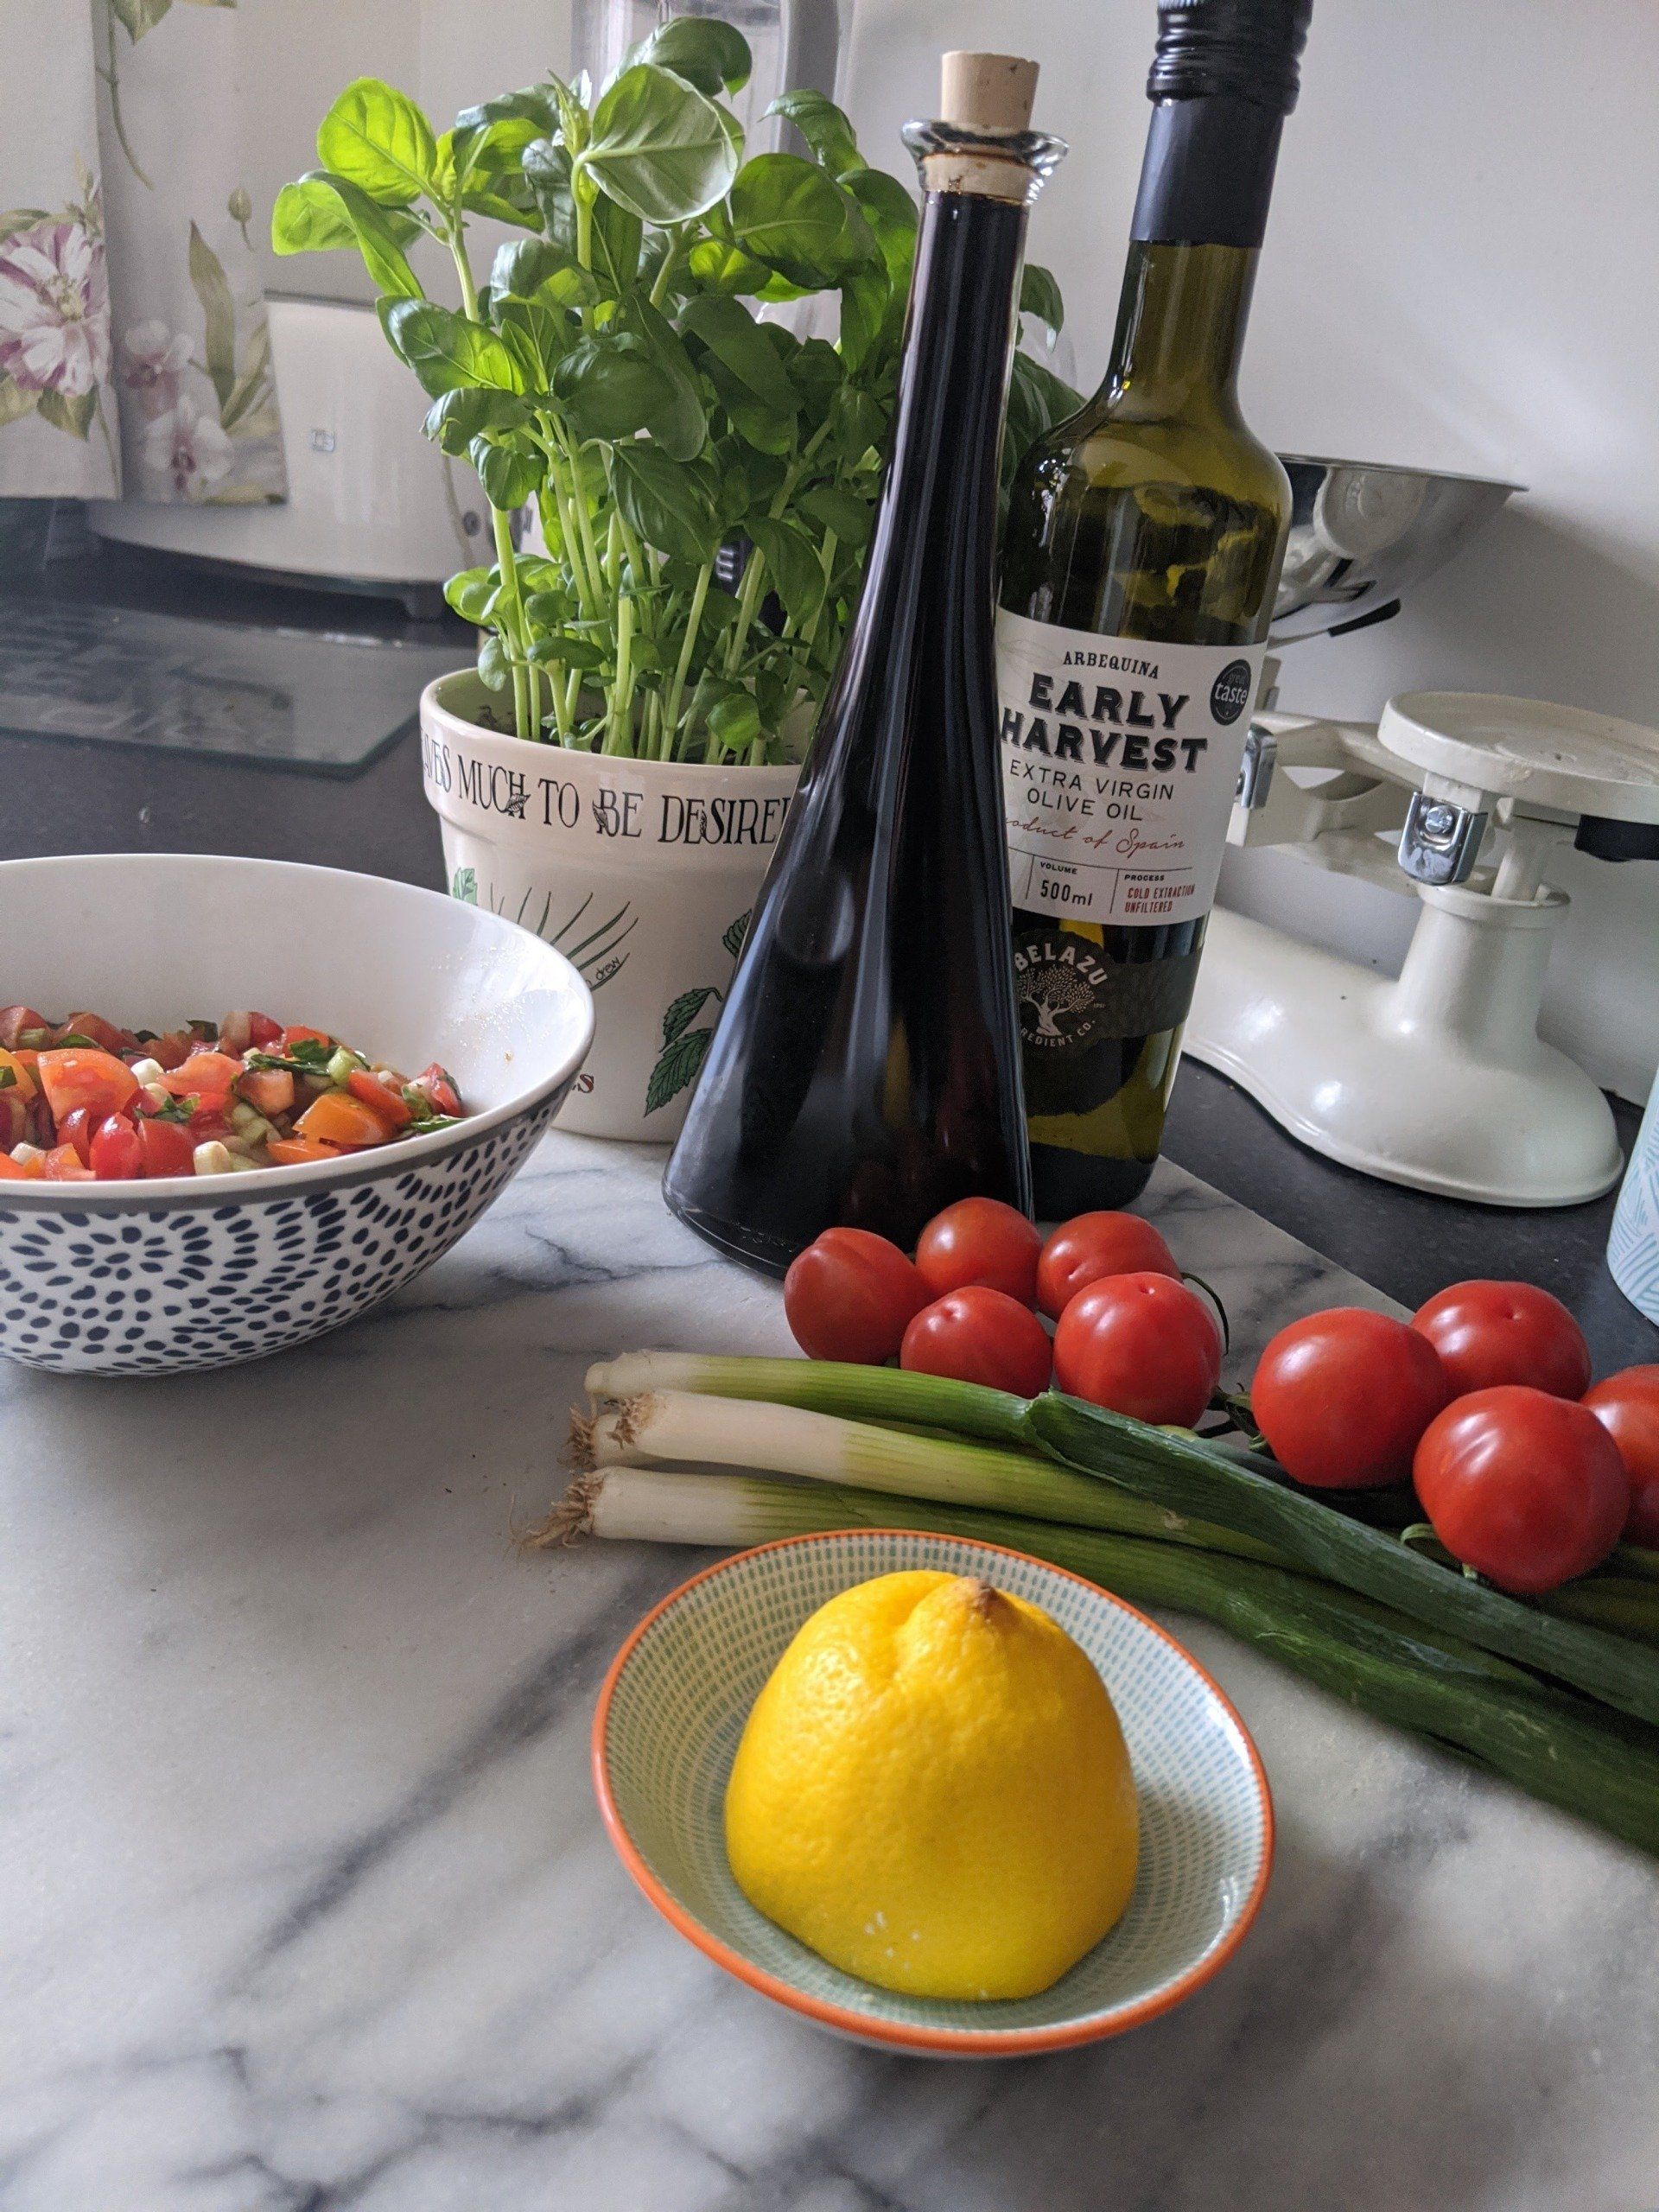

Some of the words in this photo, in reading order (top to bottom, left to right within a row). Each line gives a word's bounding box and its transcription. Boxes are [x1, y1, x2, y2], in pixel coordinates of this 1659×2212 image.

[1063, 651, 1160, 679] ARBEQUINA
[1028, 672, 1190, 730] EARLY
[1214, 682, 1248, 704] taste
[1001, 707, 1208, 773] HARVEST
[1009, 759, 1082, 791] EXTRA
[1096, 779, 1174, 800] VIRGIN
[458, 754, 530, 820] MUCH
[537, 778, 580, 829] TO
[593, 788, 644, 837] BE
[1027, 788, 1096, 816] OLIVE
[1106, 803, 1143, 821] OIL
[1005, 817, 1079, 839] oduct
[1082, 830, 1113, 849] of
[1116, 828, 1185, 858] Spain
[1039, 861, 1077, 874] VOLUME
[1040, 880, 1093, 906] 500ml
[1125, 900, 1173, 913] UNFILTERED
[1128, 887, 1150, 899] COLD
[1154, 884, 1196, 899] EXTRACTION
[1014, 943, 1109, 986] BELAZU
[1020, 1027, 1074, 1047] REDIENT
[1077, 1020, 1096, 1036] CO.
